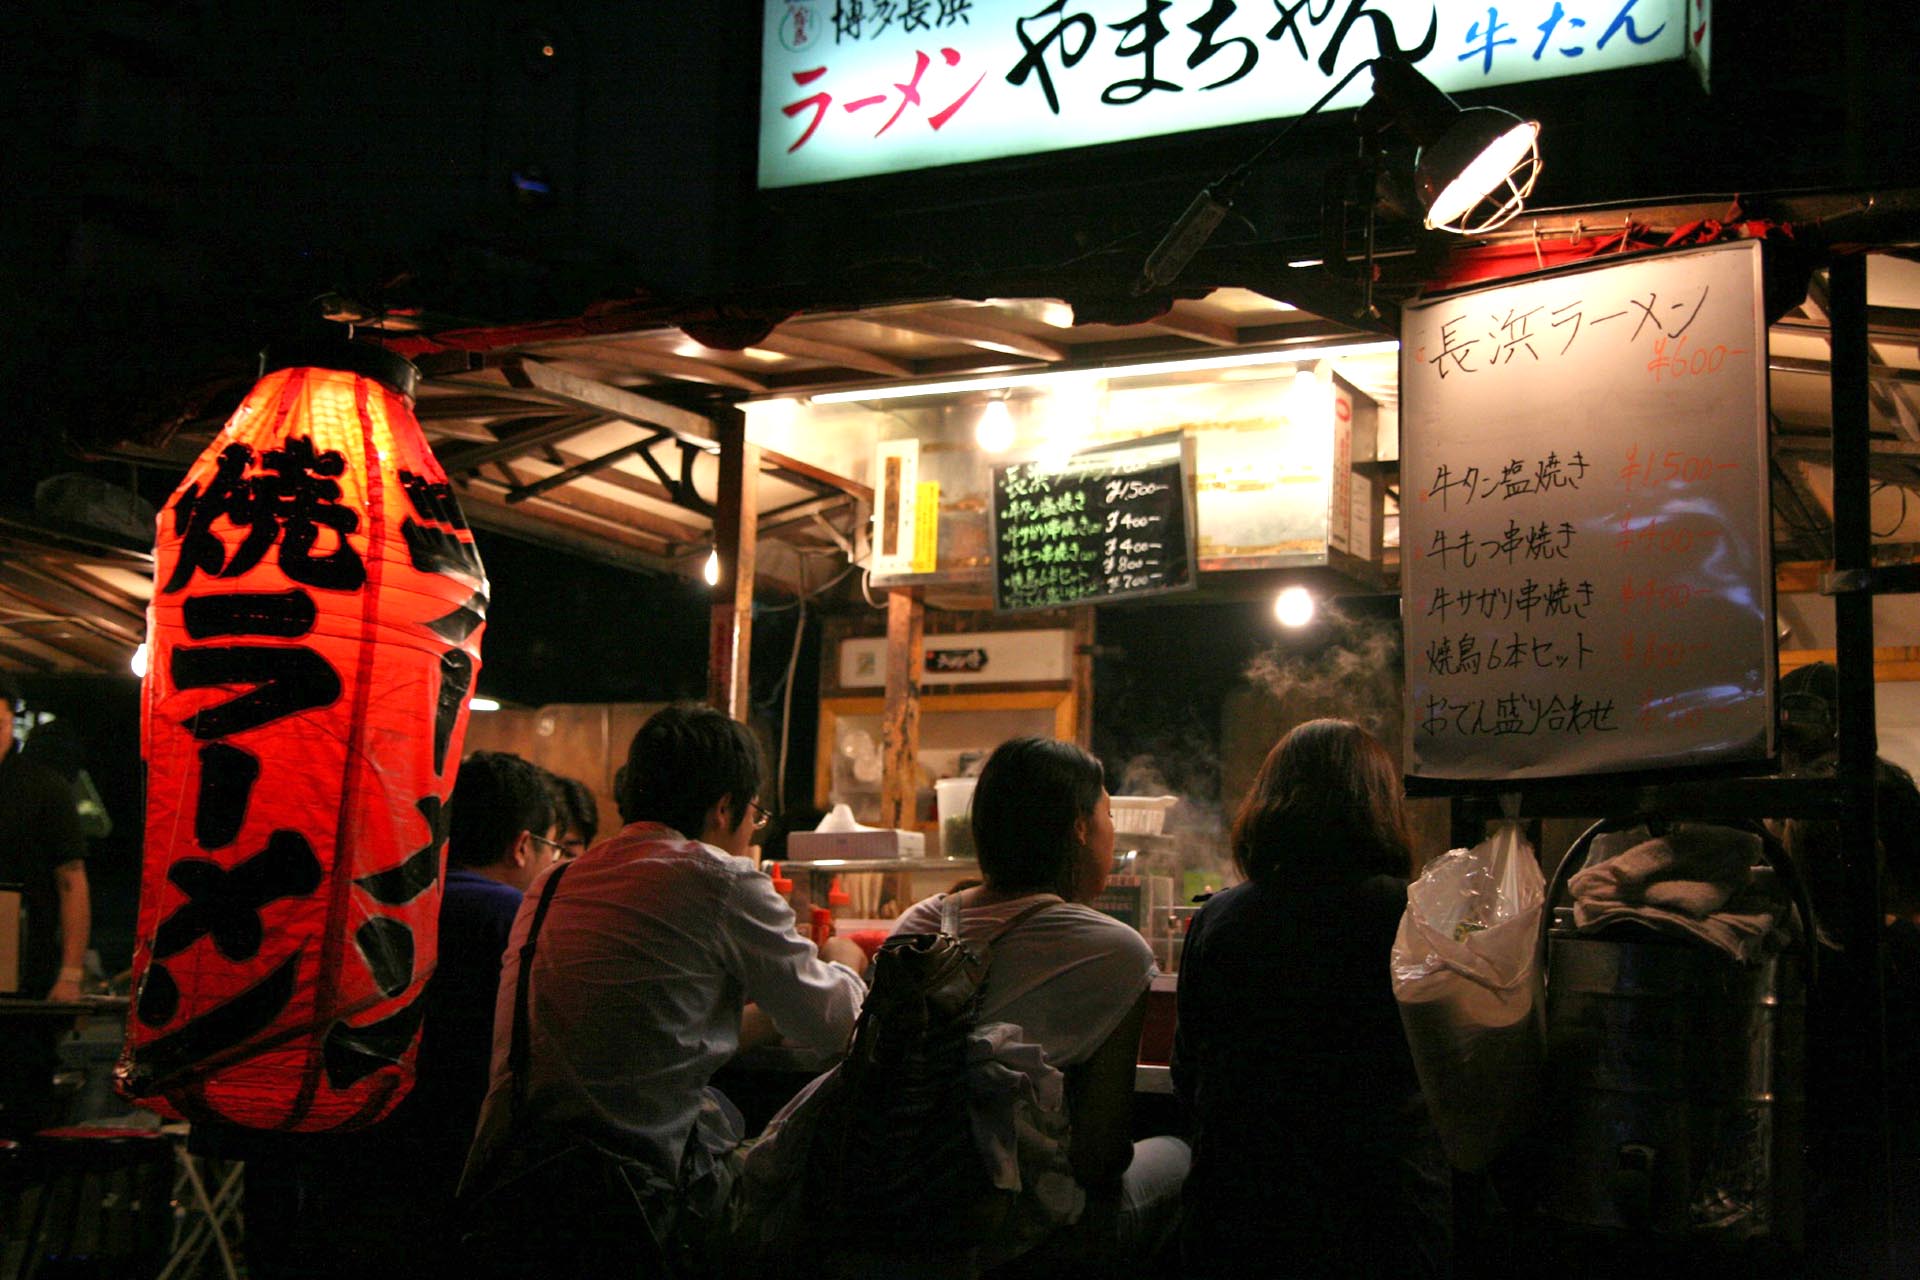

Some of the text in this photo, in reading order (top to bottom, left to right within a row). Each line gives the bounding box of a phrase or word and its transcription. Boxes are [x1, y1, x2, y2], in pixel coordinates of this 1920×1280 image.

[1005, 0, 1437, 115] やまちゃん
[1458, 0, 1666, 74] 牛たん
[782, 47, 987, 154] ラーメン
[1429, 285, 1709, 379] 長浜ラーメン
[1428, 451, 1590, 512] 牛タン塩焼き
[1428, 519, 1577, 569] 牛もつ串焼き
[1426, 632, 1594, 675] 焼鳥6本セット
[130, 435, 366, 1083] 焼ラーメン
